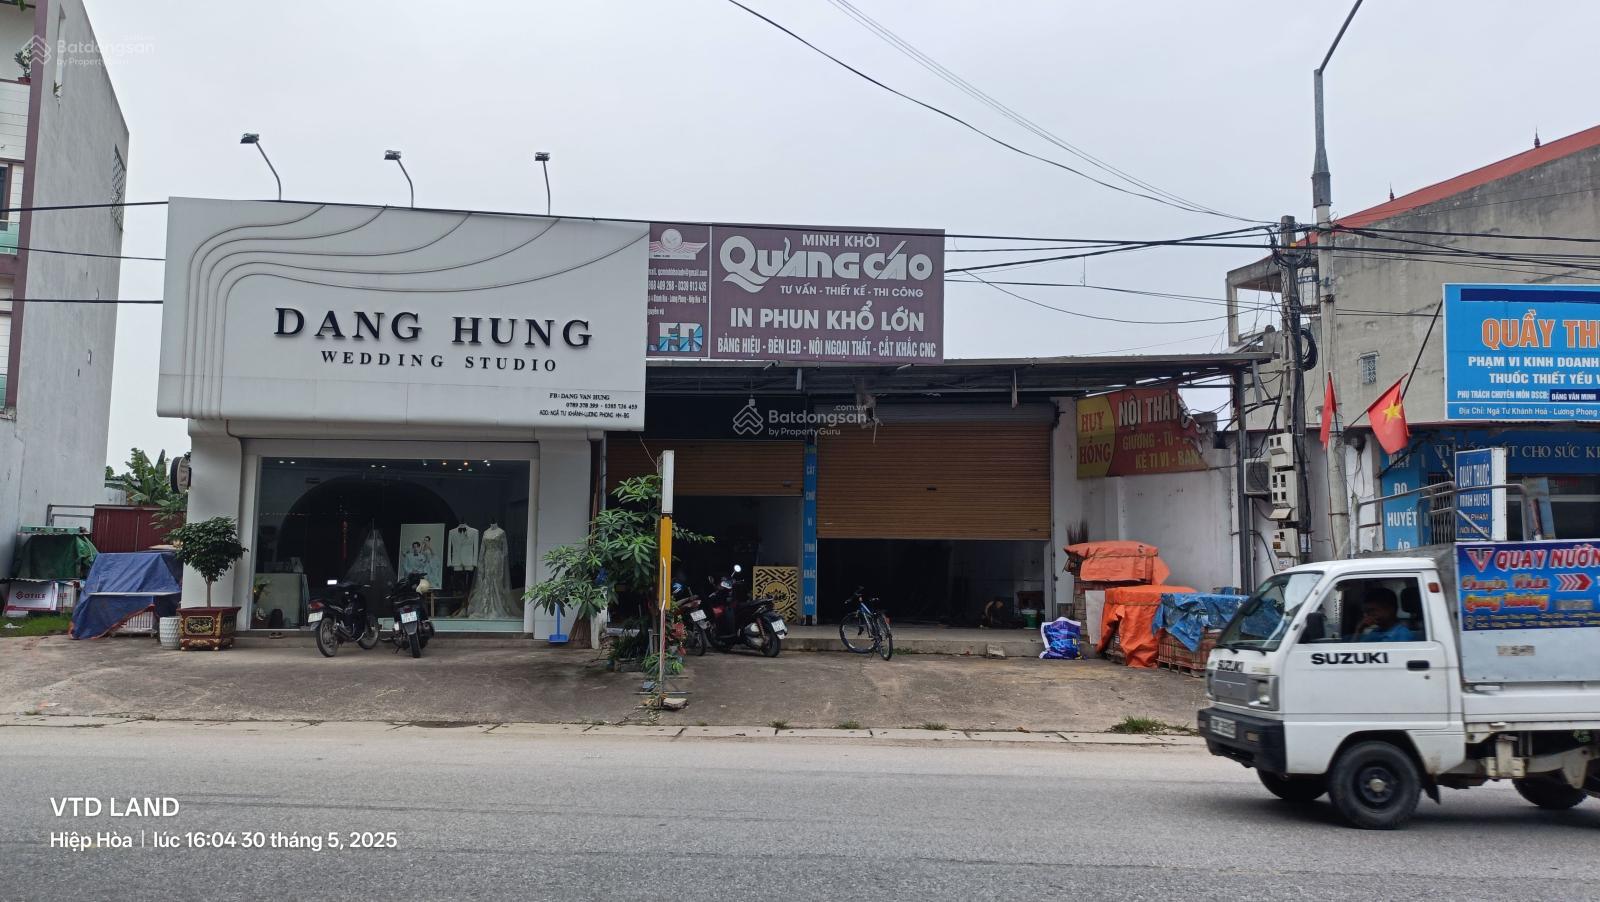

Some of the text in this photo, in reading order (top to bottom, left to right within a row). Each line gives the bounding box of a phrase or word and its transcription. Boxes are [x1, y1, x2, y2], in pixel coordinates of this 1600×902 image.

[802, 232, 880, 248] MINH KHÔI
[780, 285, 794, 295] TƯ
[795, 282, 816, 295] VẤN
[825, 283, 851, 296] THIẾT
[853, 284, 867, 296] KẾ
[874, 288, 889, 297] THI
[892, 286, 924, 297] CÔNG
[730, 300, 924, 332] IN PHUN KHỔ LỚN
[273, 306, 594, 348] DANG HUNG
[718, 332, 740, 353] BẢNG
[742, 335, 761, 357] HIỆU
[767, 336, 785, 354] ĐÈN
[786, 340, 801, 355] LED
[808, 336, 823, 358] NỘI
[825, 340, 850, 359] NGOẠI
[851, 337, 872, 357] THẤT
[879, 335, 894, 357] CẮT
[896, 336, 918, 358] KHẮC
[920, 343, 936, 358] CNC
[320, 349, 558, 373] WEDDING STUDIO
[1468, 356, 1600, 369] PHẠM VI KINH DOANH
[1489, 370, 1529, 384] THUỐC
[1532, 370, 1566, 384] THIẾT
[1569, 371, 1593, 385] YẾU
[1581, 393, 1597, 401] MINH
[1118, 394, 1142, 431] NỘI
[1511, 407, 1533, 415] Khánh
[1575, 408, 1598, 417] Phong
[1080, 411, 1105, 432] HUY
[1522, 445, 1551, 458] CHO
[1554, 442, 1581, 458] SỨC
[1387, 506, 1418, 527] HUYẾT
[1494, 550, 1548, 572] QUAY
[1217, 660, 1244, 672] SUZUKI
[1311, 652, 1389, 665] SUZUKI
